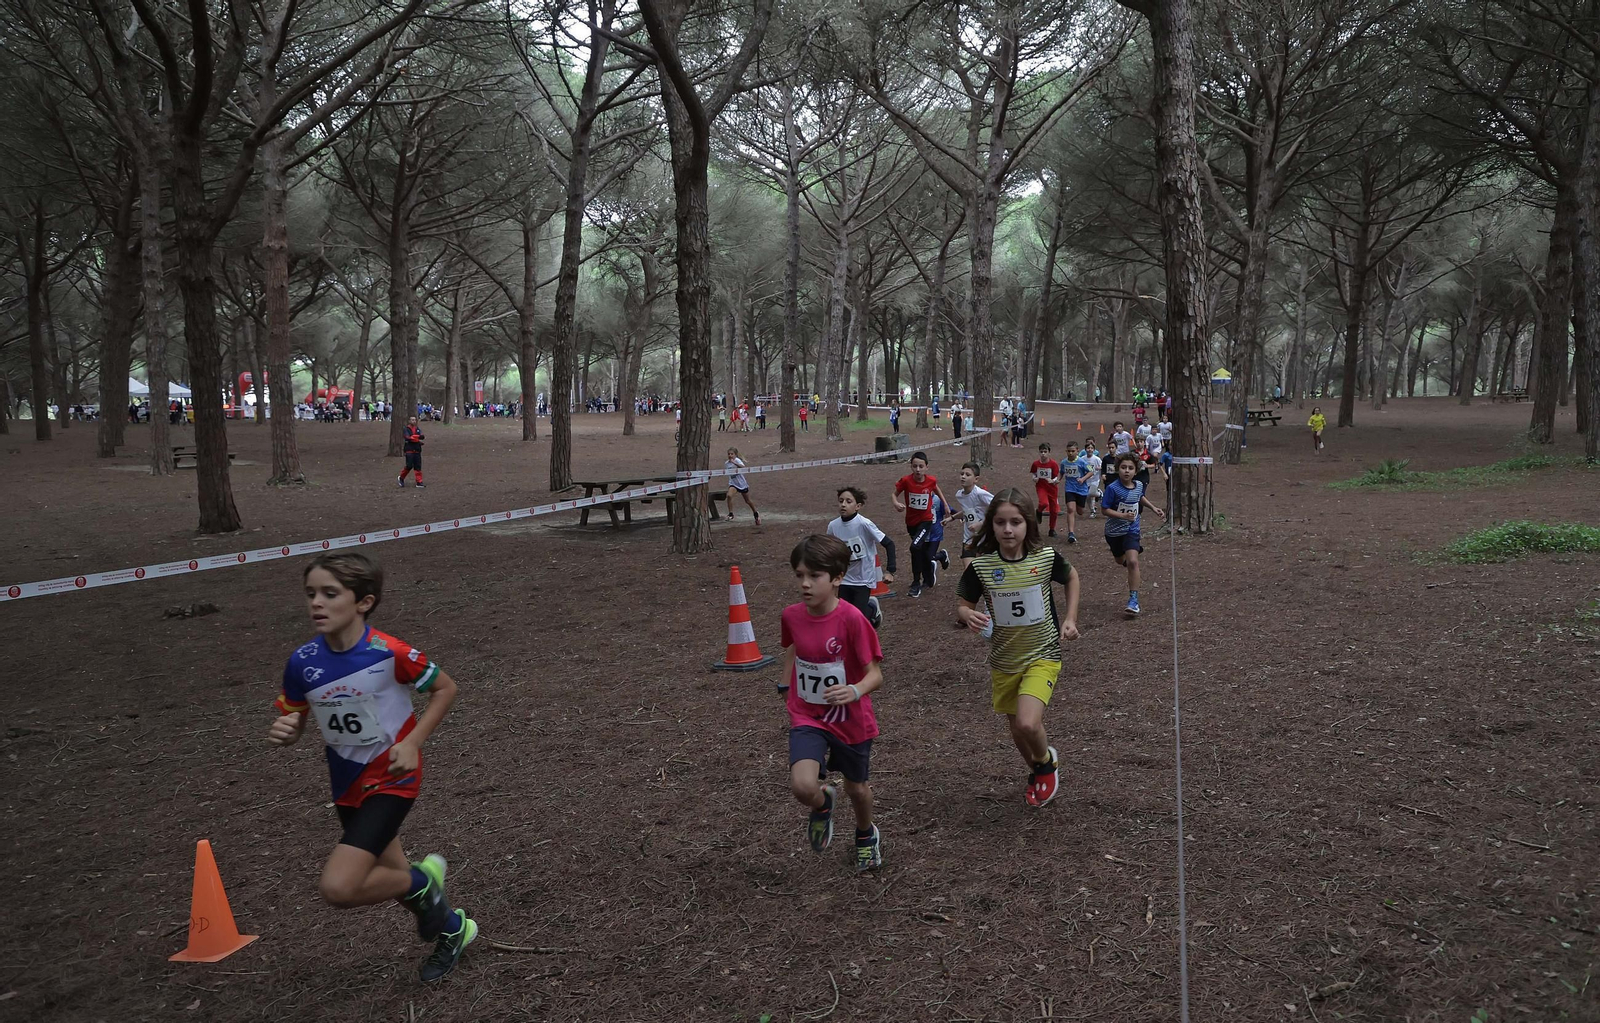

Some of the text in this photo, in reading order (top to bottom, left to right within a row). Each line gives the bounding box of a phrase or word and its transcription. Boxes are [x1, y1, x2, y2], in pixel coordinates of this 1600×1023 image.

[910, 497, 928, 505] 212
[1011, 600, 1025, 618] 5
[798, 662, 818, 671] CROSS
[798, 673, 839, 694] 179
[328, 713, 362, 734] 46
